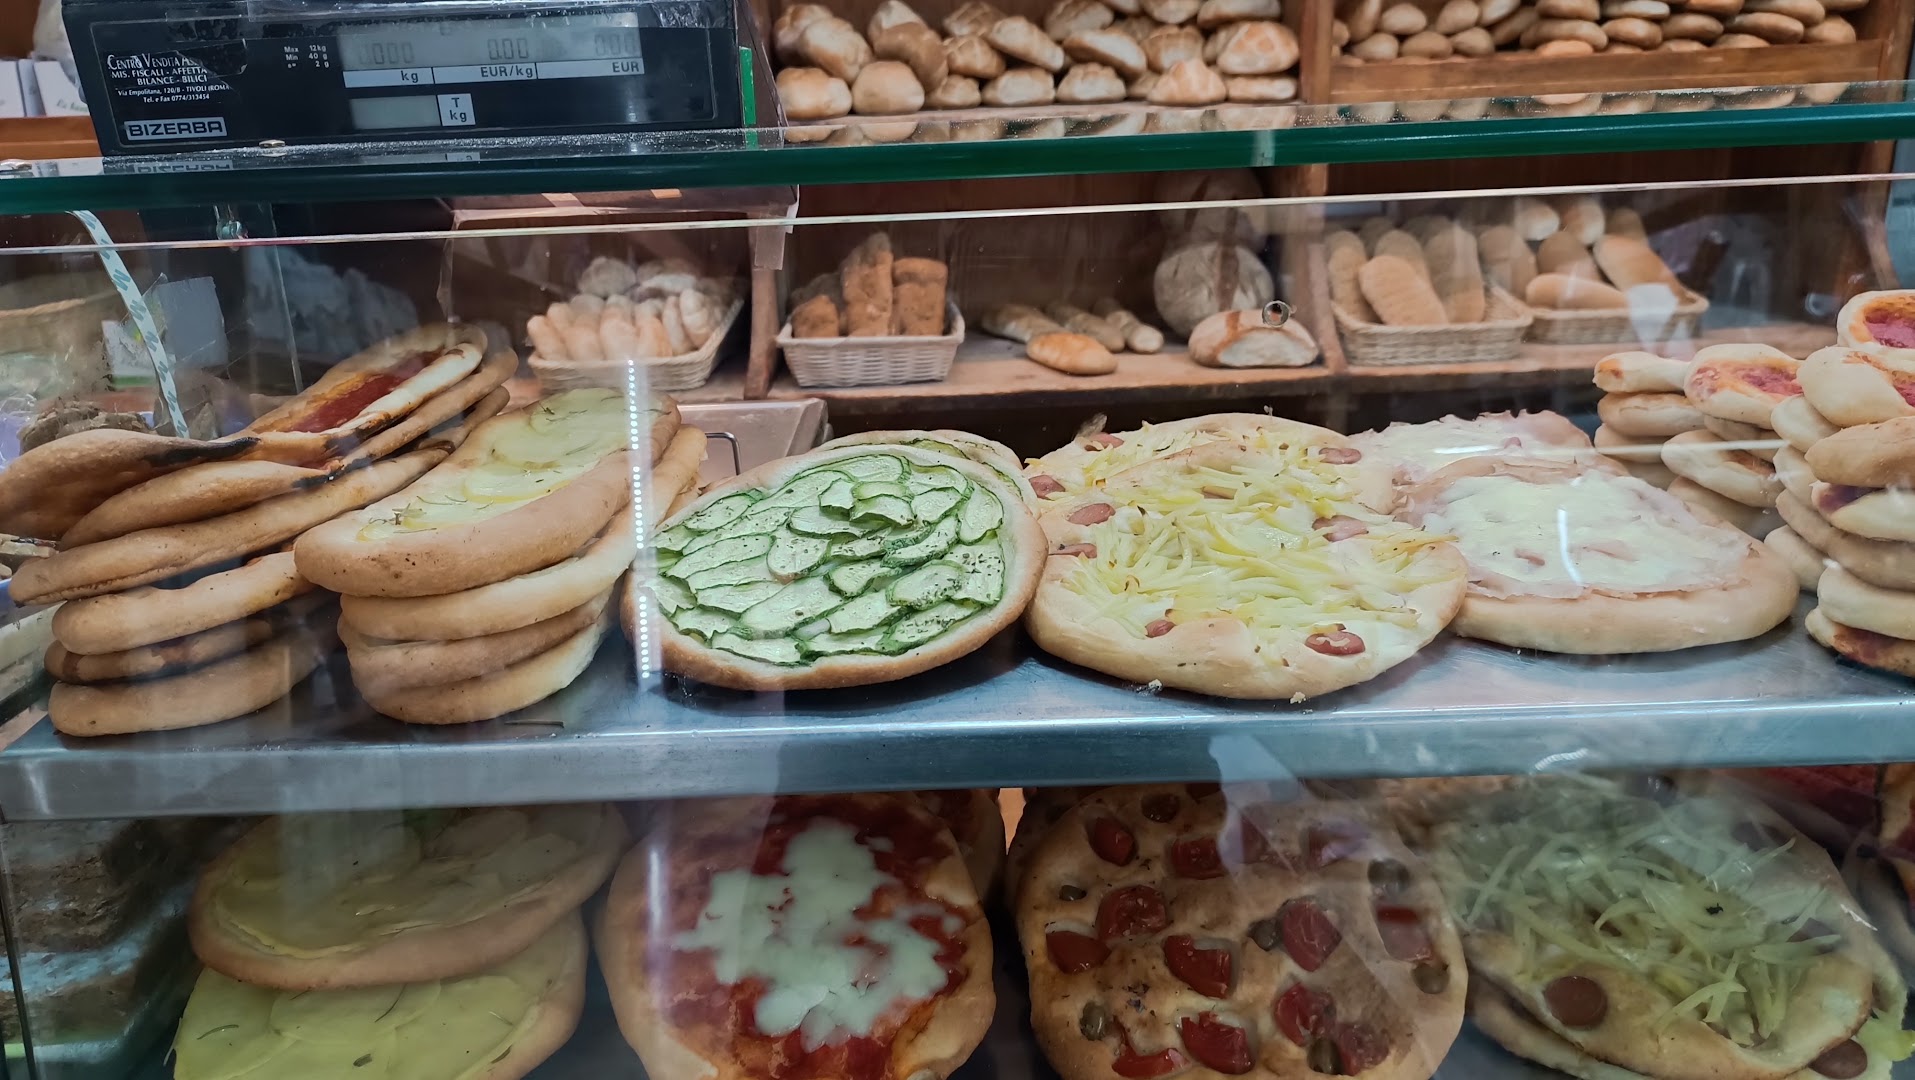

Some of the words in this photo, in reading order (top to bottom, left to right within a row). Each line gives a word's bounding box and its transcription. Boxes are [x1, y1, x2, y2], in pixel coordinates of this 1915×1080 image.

[285, 53, 299, 61] Min
[308, 52, 319, 60] 40
[315, 60, 320, 68] 2
[612, 62, 640, 73] EUR
[111, 70, 131, 79] MIS.
[131, 68, 165, 78] FISCALI
[400, 70, 419, 83] kg
[480, 64, 533, 78] EUR/kg
[137, 76, 175, 86] BILANCE
[181, 74, 208, 83] BILICI
[451, 97, 460, 108] T
[449, 109, 468, 122] kg
[128, 121, 223, 137] BIZERBA
